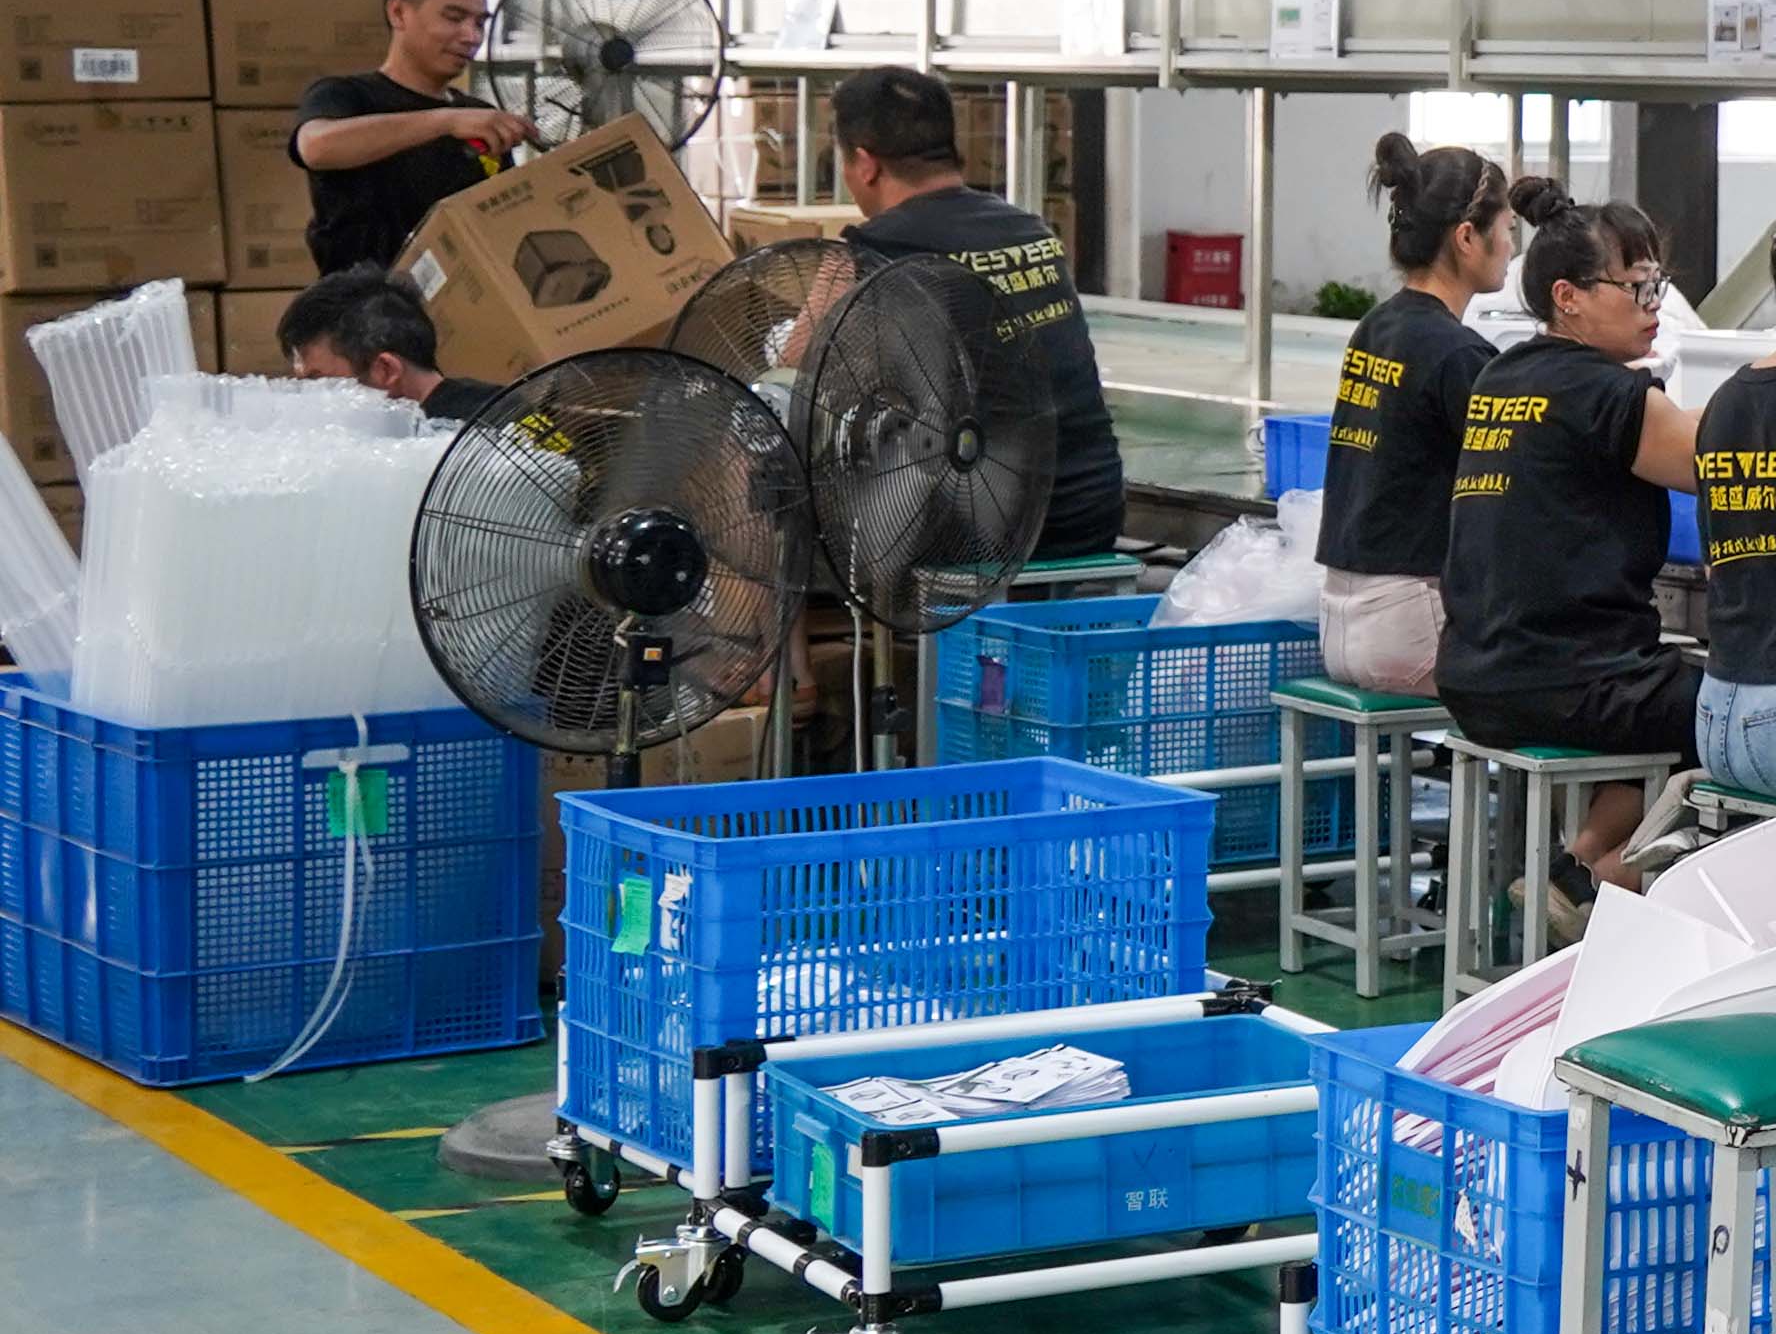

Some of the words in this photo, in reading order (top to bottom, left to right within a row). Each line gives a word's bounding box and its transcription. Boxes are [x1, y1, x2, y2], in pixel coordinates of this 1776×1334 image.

[1344, 347, 1405, 388] ESVEER
[1466, 394, 1549, 423] ESVEER
[1125, 1187, 1169, 1212] 智联
